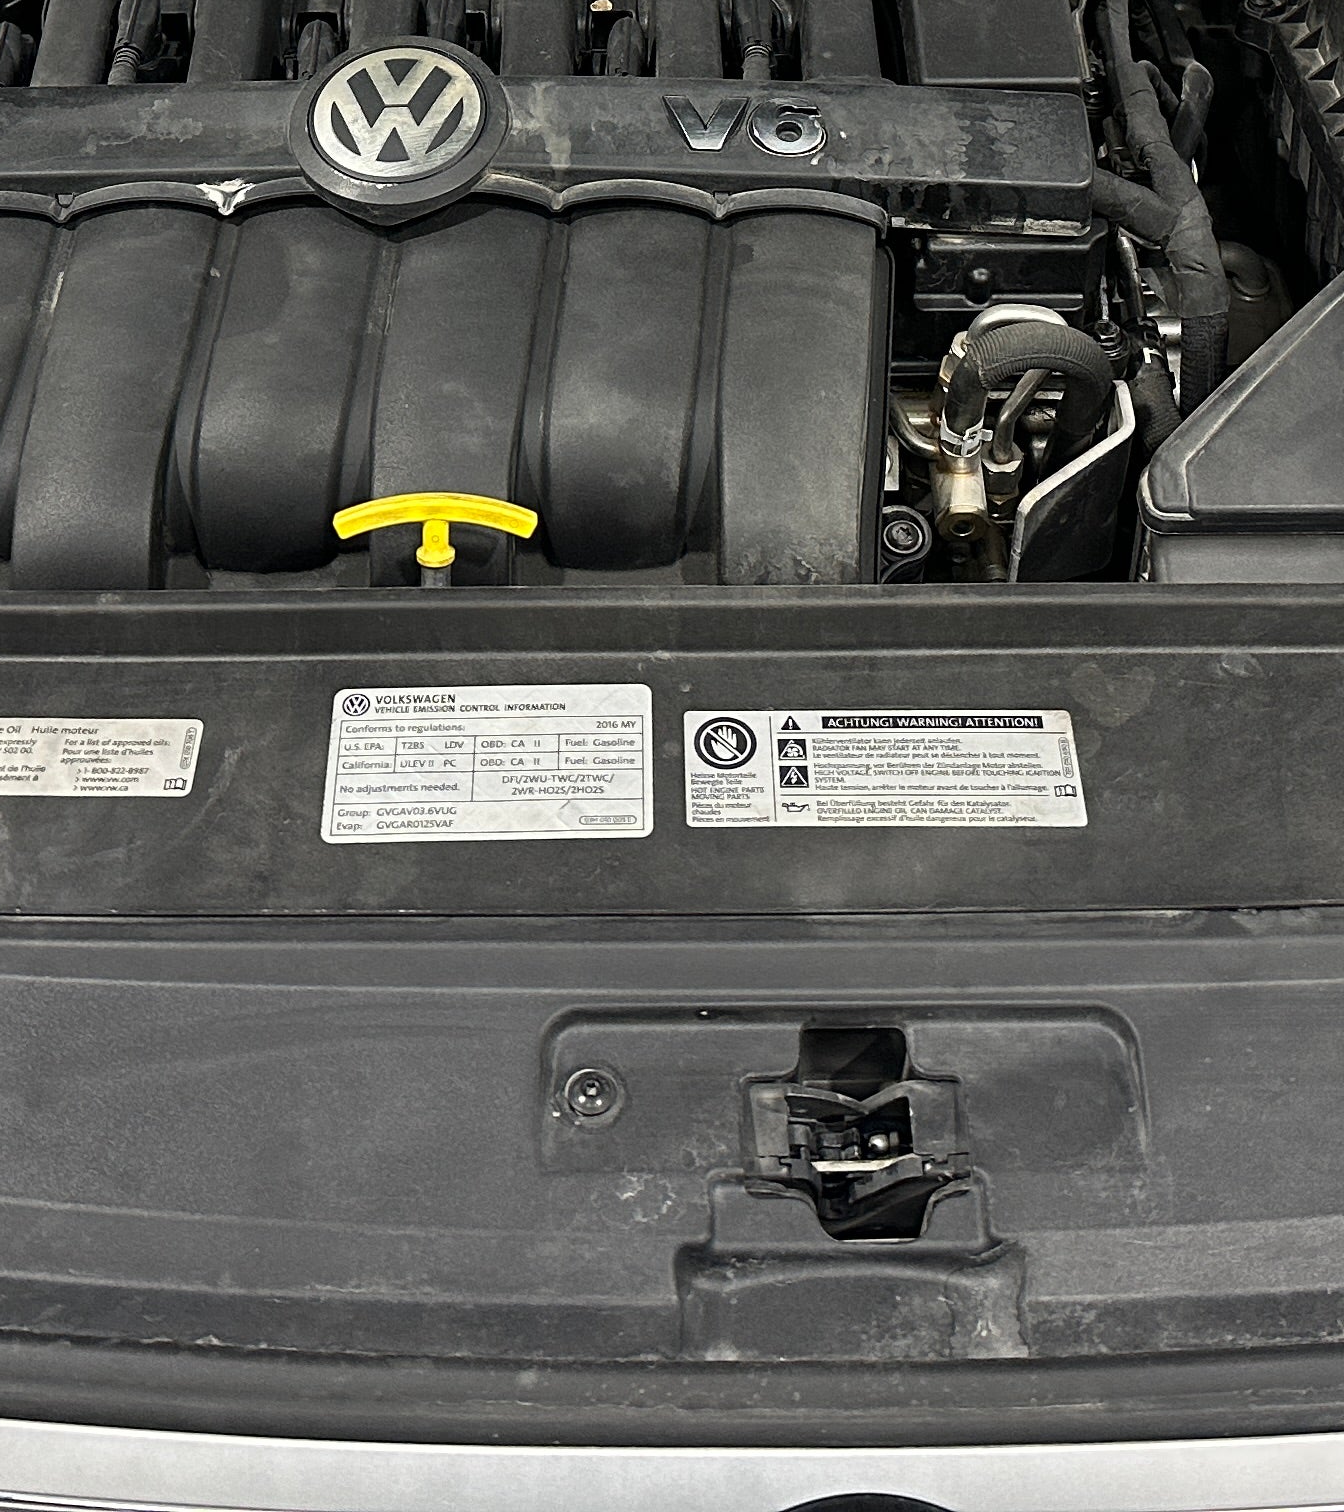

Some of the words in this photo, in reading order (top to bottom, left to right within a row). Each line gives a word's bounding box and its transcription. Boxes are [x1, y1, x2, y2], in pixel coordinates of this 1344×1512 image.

[662, 95, 826, 156] V6
[375, 694, 456, 705] VOLKSWAGEN
[375, 706, 410, 714] VEHICLE
[413, 705, 456, 713] EMISSION
[460, 704, 500, 712] CONTROL
[504, 703, 566, 711] INFORMATION
[596, 721, 618, 729] 2016
[621, 720, 636, 728] MY
[828, 718, 893, 727] ACHTUNG!
[897, 717, 962, 727] WARNING!
[966, 717, 1038, 727] ATTENTION!
[7, 725, 22, 734] Oil
[31, 726, 59, 734] Huile
[60, 726, 99, 734] moteur
[345, 725, 393, 734] Conforms
[396, 724, 406, 732] to
[444, 741, 464, 749] LDV
[511, 740, 525, 748] CA
[565, 738, 588, 746] Fuel:
[593, 738, 636, 747] Gasoline
[443, 759, 456, 767] PC
[510, 758, 525, 766] CA
[565, 757, 587, 765] Fuel:
[592, 756, 636, 765] Gasoline
[339, 785, 354, 793] No
[356, 784, 419, 795] adjustments
[421, 783, 460, 791] needed.
[337, 809, 371, 818] Group:
